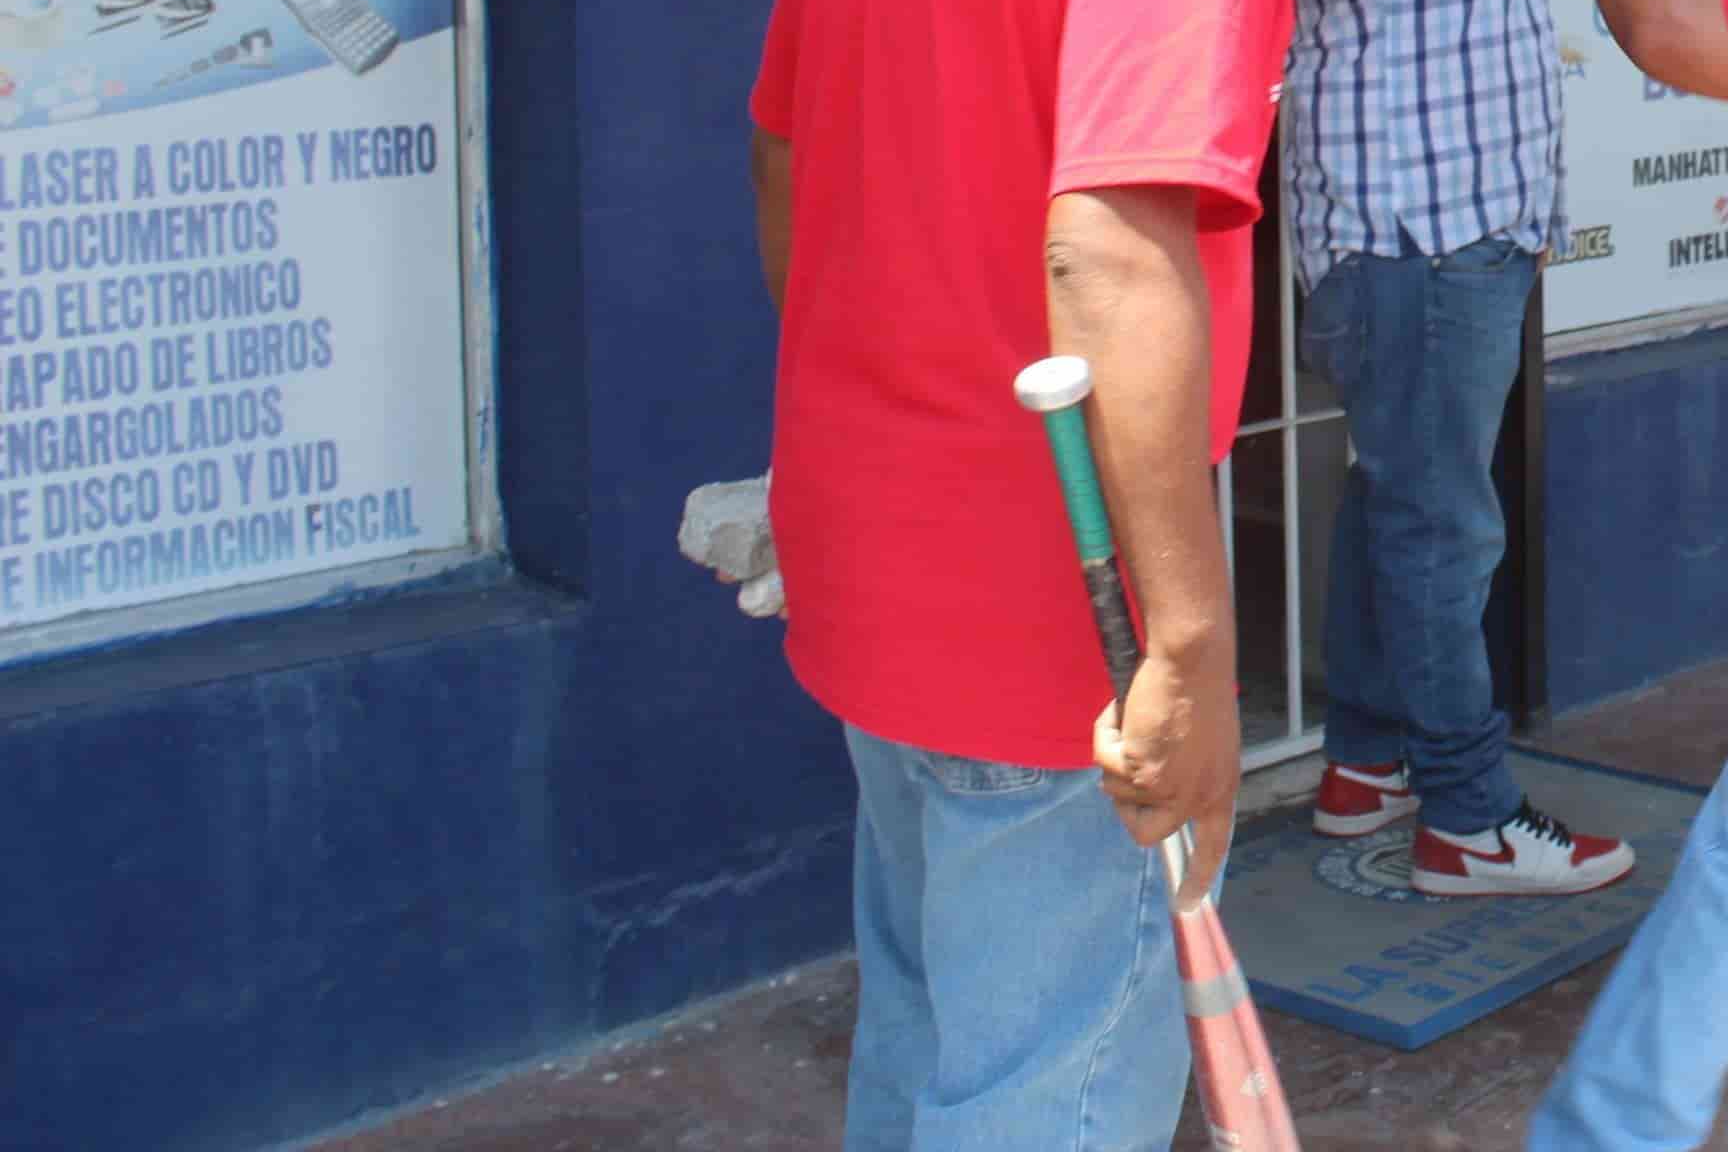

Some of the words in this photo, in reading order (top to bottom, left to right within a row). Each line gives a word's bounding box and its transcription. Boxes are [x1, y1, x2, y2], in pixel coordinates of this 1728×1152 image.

[132, 142, 156, 199] A
[168, 134, 286, 195] COLOR
[296, 132, 319, 184] Y
[329, 123, 438, 183] NEGRO
[19, 199, 279, 276] DOCUMENTOS
[56, 259, 301, 339] ELECTRONICO
[151, 333, 197, 393] DE
[206, 317, 335, 385] LIBROS
[43, 466, 161, 540] DISCO
[173, 456, 222, 518] CD
[234, 450, 256, 506] Y
[269, 439, 339, 501] DVD
[35, 508, 295, 609] INFORMACION
[306, 486, 421, 554] FISCAL
